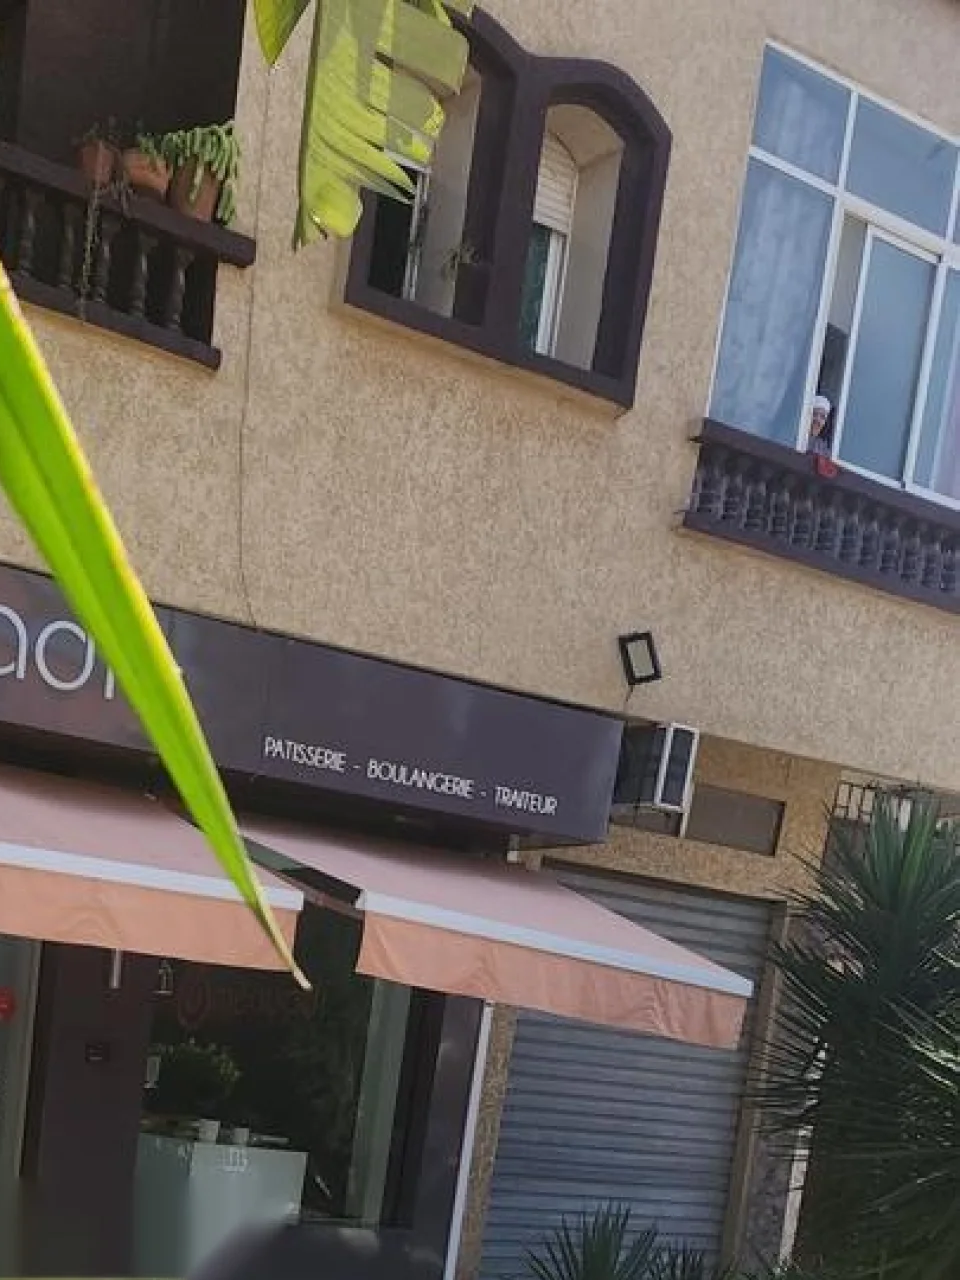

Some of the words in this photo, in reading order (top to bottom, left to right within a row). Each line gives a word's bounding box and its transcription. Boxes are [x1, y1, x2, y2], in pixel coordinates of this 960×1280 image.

[264, 736, 347, 773] PATISSERIE
[366, 758, 474, 800] BOULANGERIE
[494, 786, 558, 816] TRAITEUR
